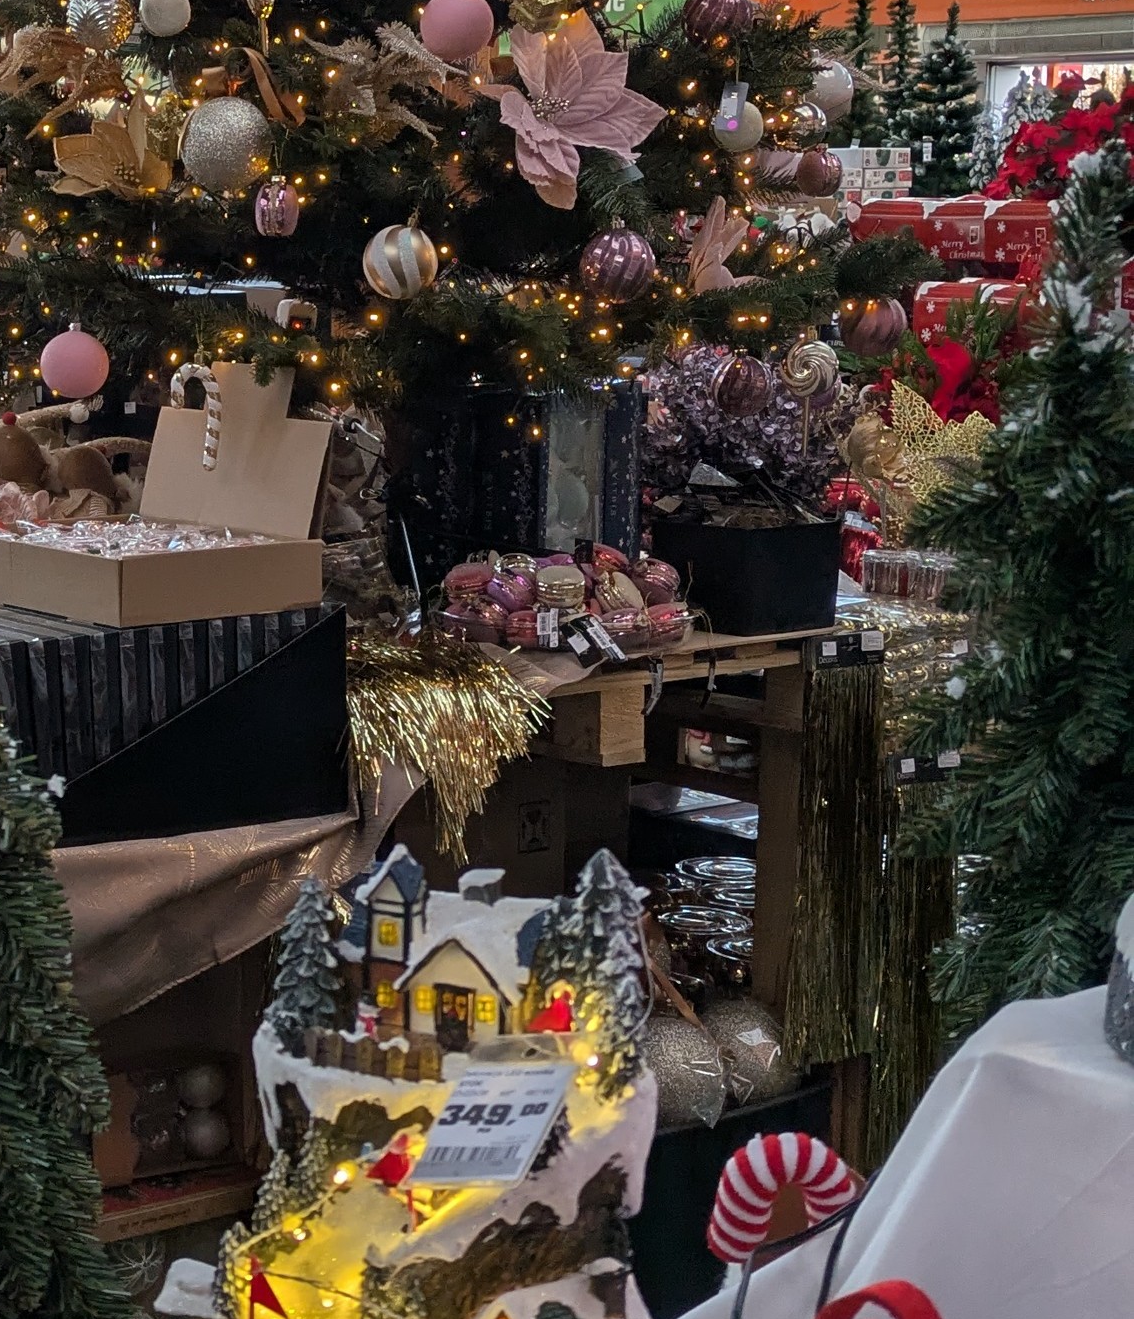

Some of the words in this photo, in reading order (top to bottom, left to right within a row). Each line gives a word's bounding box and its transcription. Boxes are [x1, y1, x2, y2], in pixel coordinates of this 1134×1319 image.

[941, 240, 964, 250] Merry
[1006, 242, 1031, 251] Merry
[438, 1102, 549, 1127] 349,00
